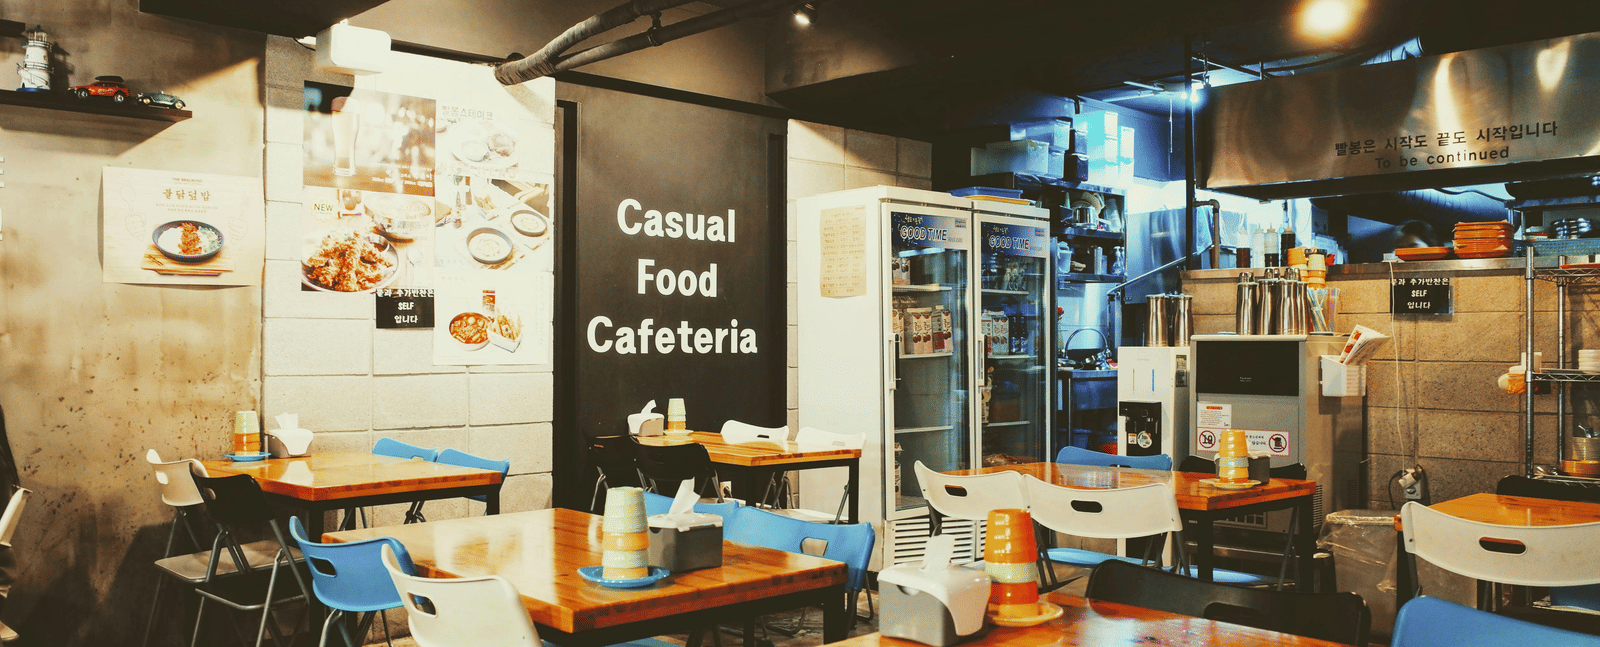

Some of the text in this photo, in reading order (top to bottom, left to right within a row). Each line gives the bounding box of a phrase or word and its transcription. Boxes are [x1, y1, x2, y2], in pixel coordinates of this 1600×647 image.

[1334, 120, 1558, 156] 빨봉은 시작도 끝도 시작입니다
[1375, 146, 1510, 169] To be continued
[313, 203, 334, 212] NEW
[616, 198, 736, 243] Casual
[900, 225, 948, 241] GOOD TIME
[988, 234, 1030, 250] GOOD TIME
[637, 258, 718, 298] Food
[1411, 289, 1427, 298] SELF
[397, 301, 415, 311] SELF
[1407, 301, 1431, 310] 입니다
[393, 314, 418, 324] 입니다
[586, 315, 758, 354] Cafeteria
